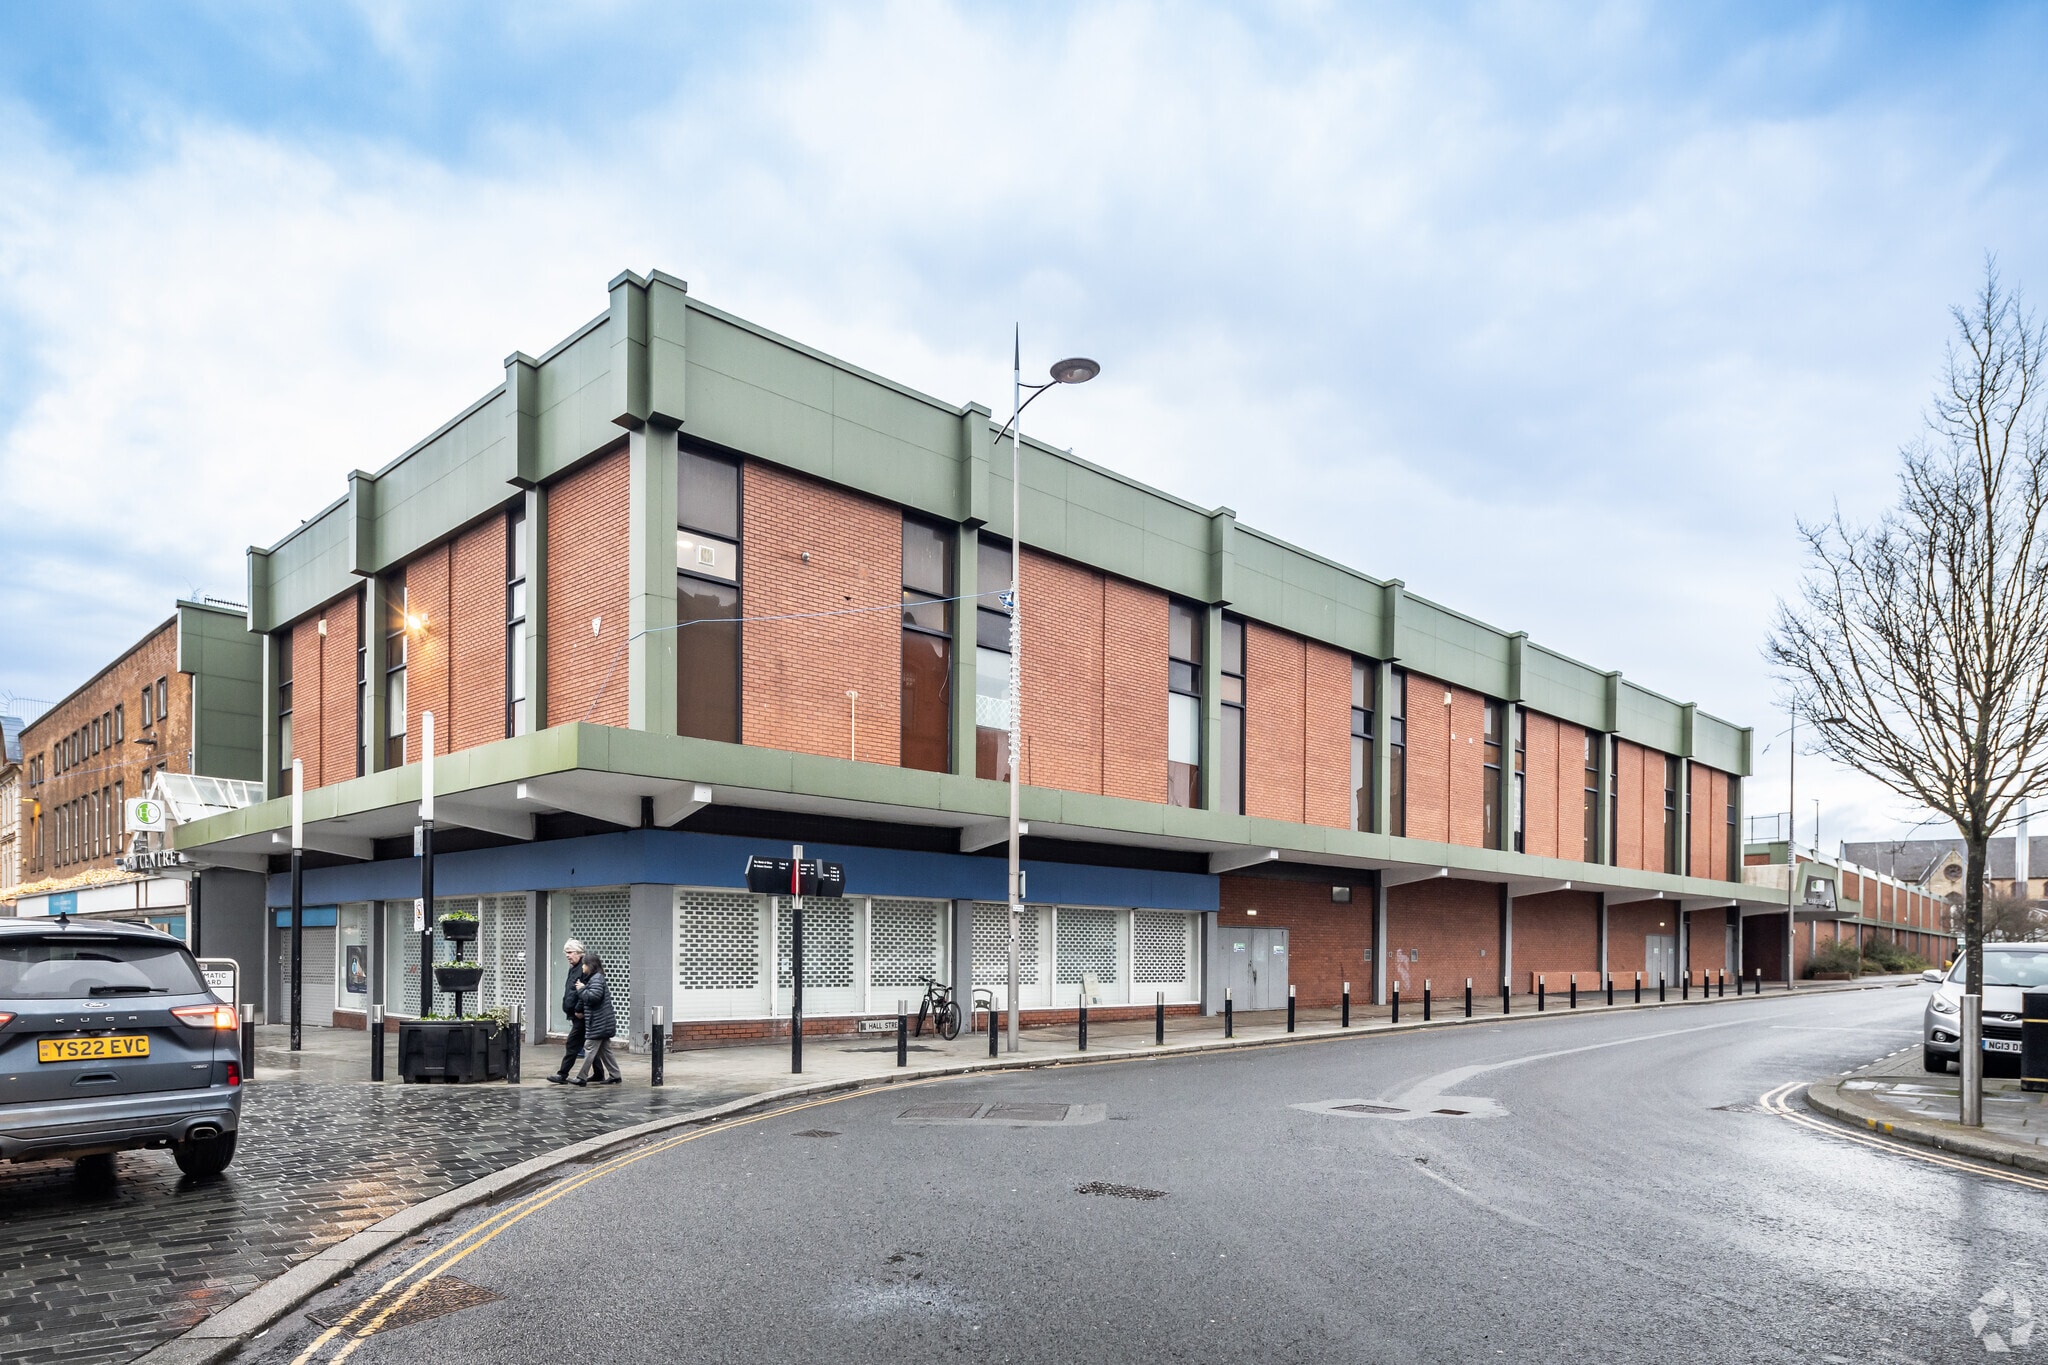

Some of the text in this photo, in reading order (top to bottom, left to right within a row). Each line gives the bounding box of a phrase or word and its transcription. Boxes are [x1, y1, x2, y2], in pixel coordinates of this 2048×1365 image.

[139, 851, 177, 869] CENTRE
[53, 1039, 146, 1057] YS22 EVC
[1989, 1042, 2010, 1051] NG13
